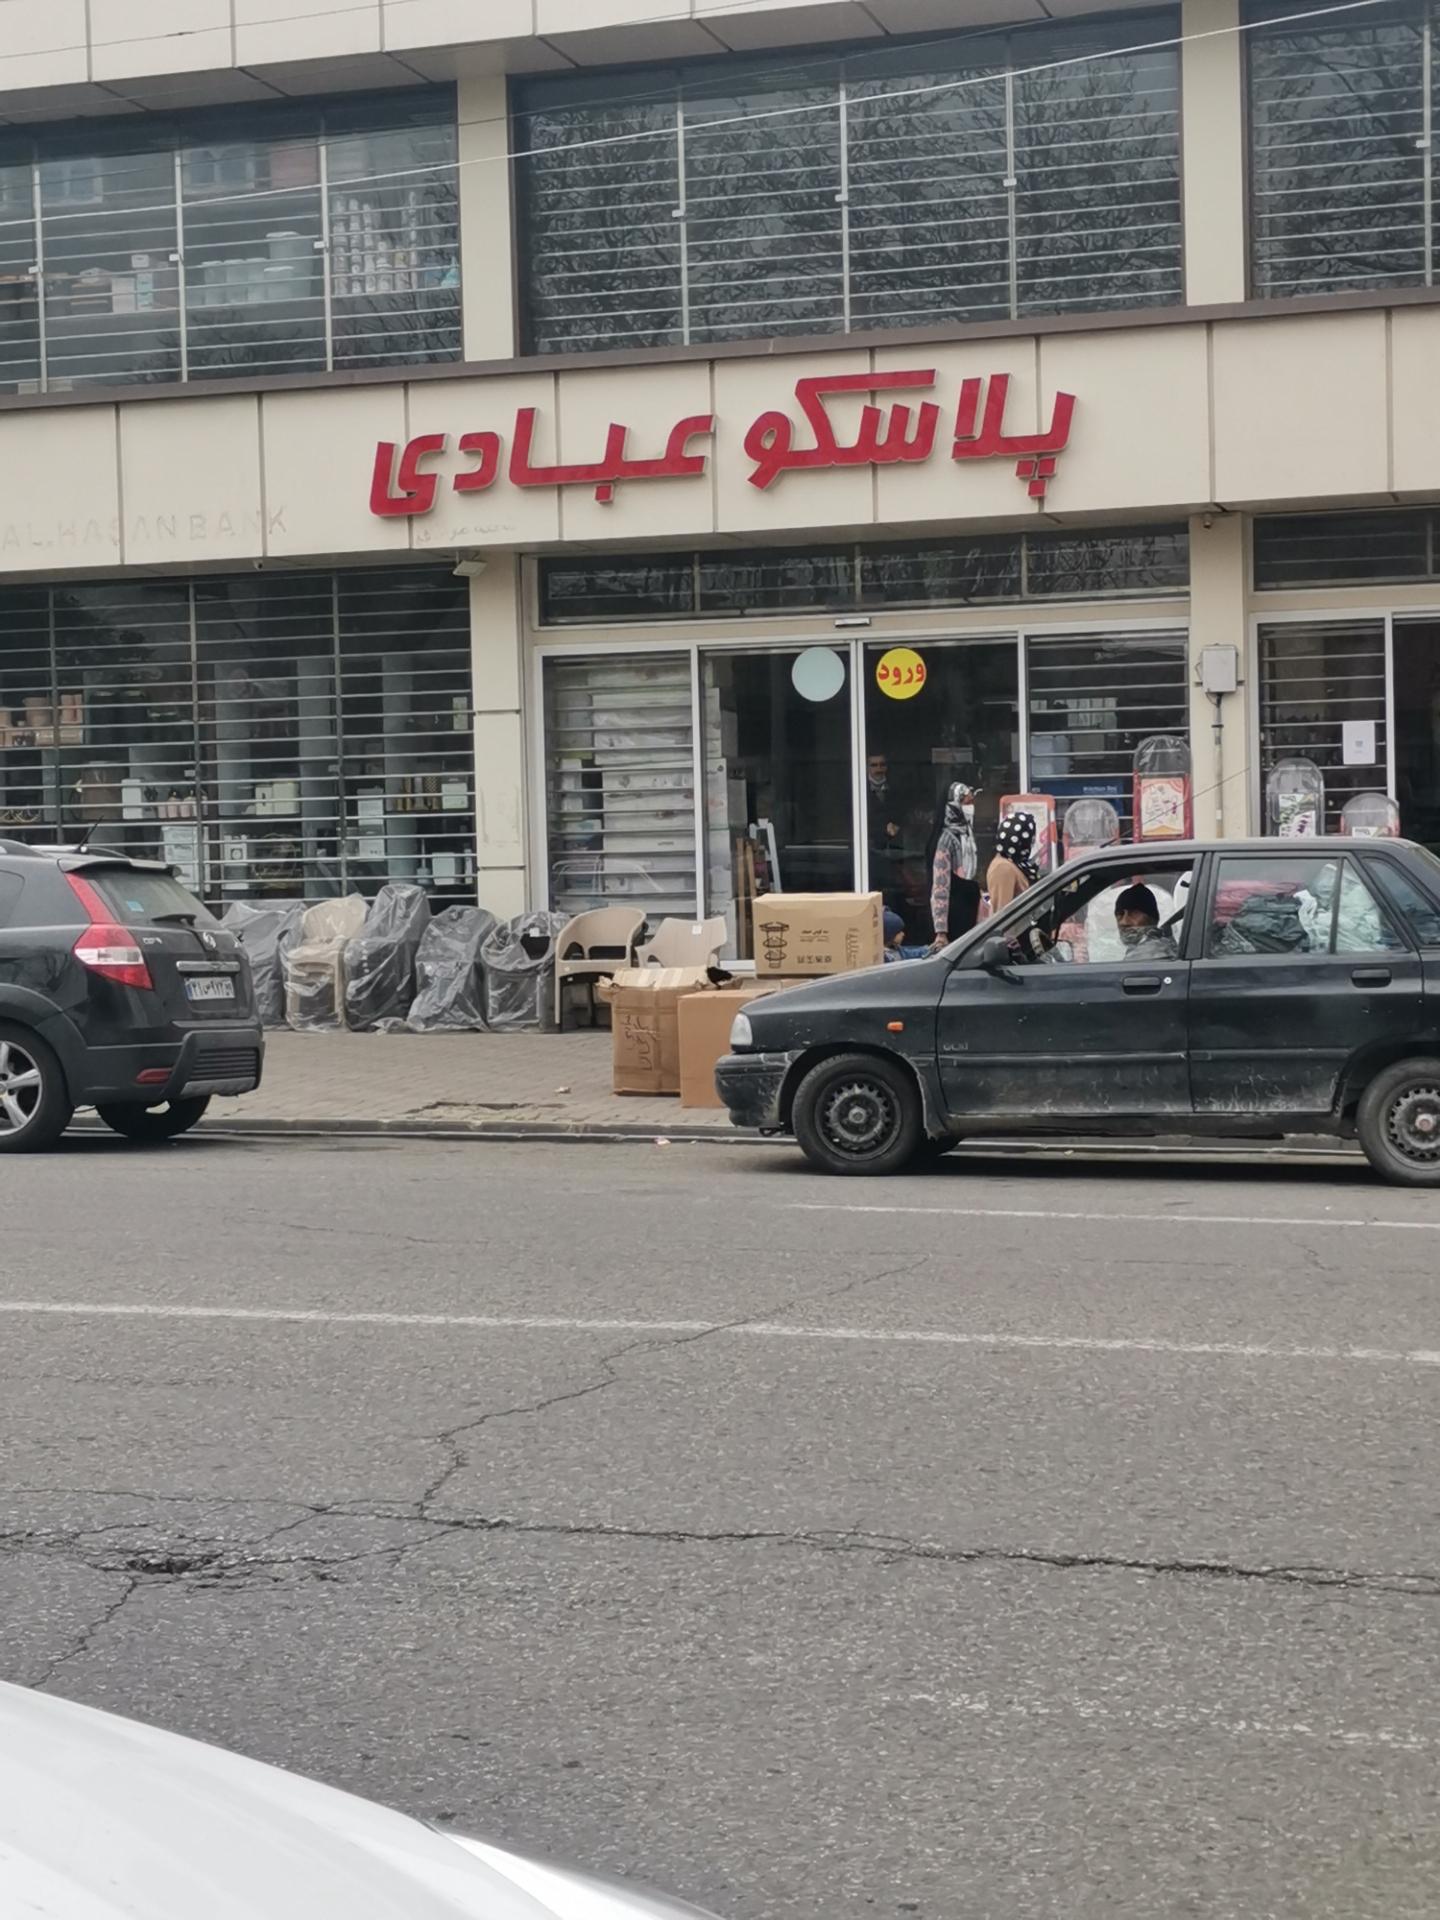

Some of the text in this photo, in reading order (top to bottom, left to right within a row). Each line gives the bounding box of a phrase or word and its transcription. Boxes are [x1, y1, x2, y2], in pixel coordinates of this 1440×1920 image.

[369, 368, 1078, 517] پلاسکو عبادی
[878, 663, 925, 686] ورود
